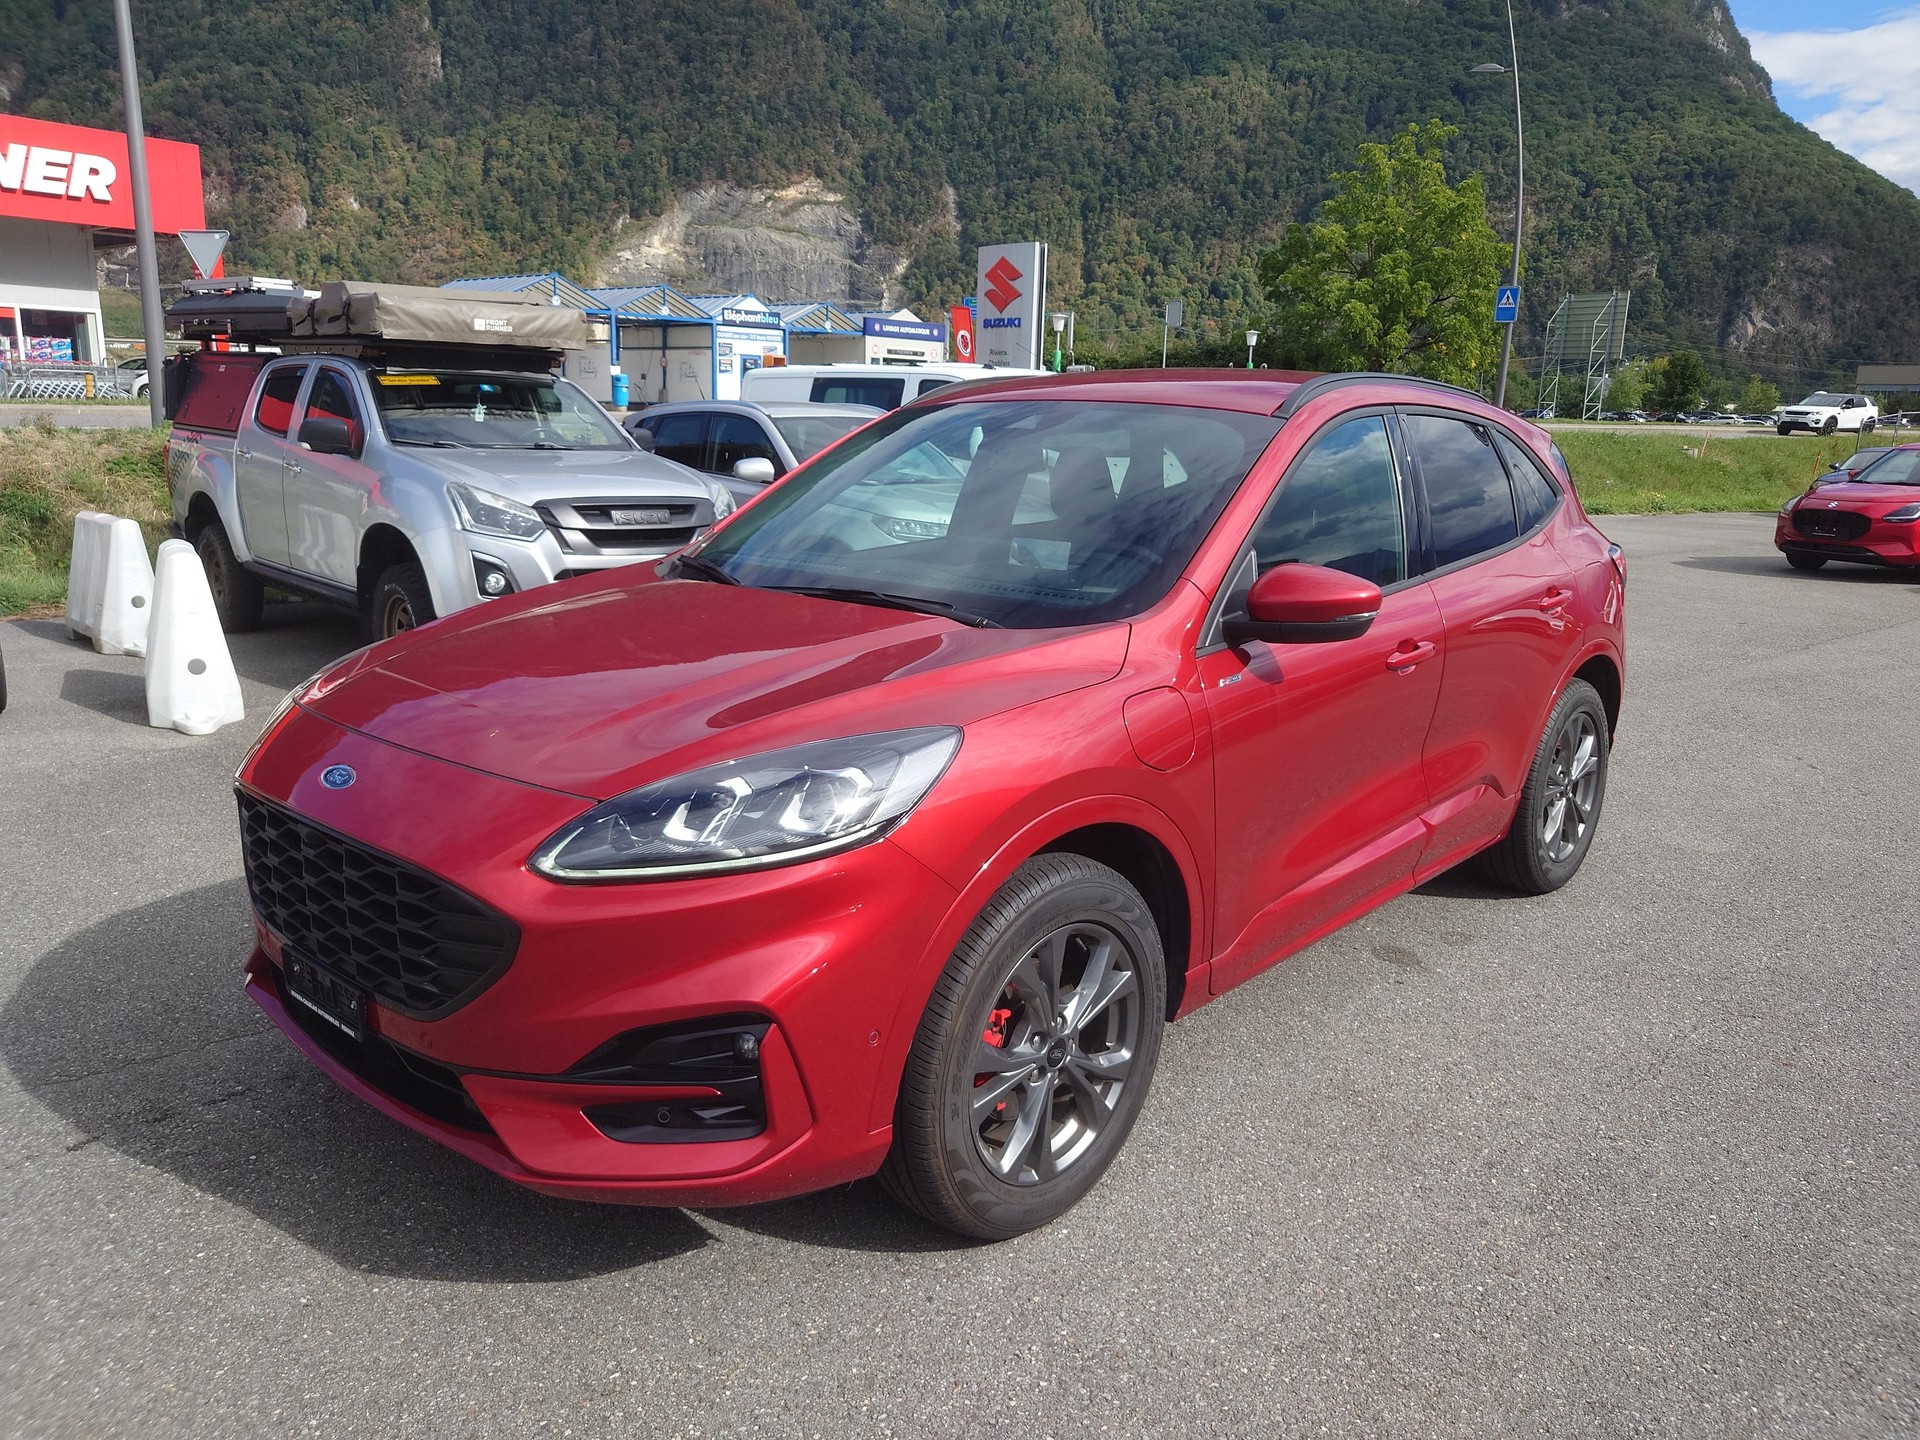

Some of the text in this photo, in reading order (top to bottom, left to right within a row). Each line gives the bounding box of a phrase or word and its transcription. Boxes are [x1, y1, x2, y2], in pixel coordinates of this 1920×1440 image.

[983, 317, 1021, 328] SUZUKI
[882, 324, 930, 335] LAVAGE AUTOMATIQUE
[613, 511, 671, 525] ISUZU
[326, 768, 349, 785] Ford
[1051, 1048, 1064, 1058] Ford
